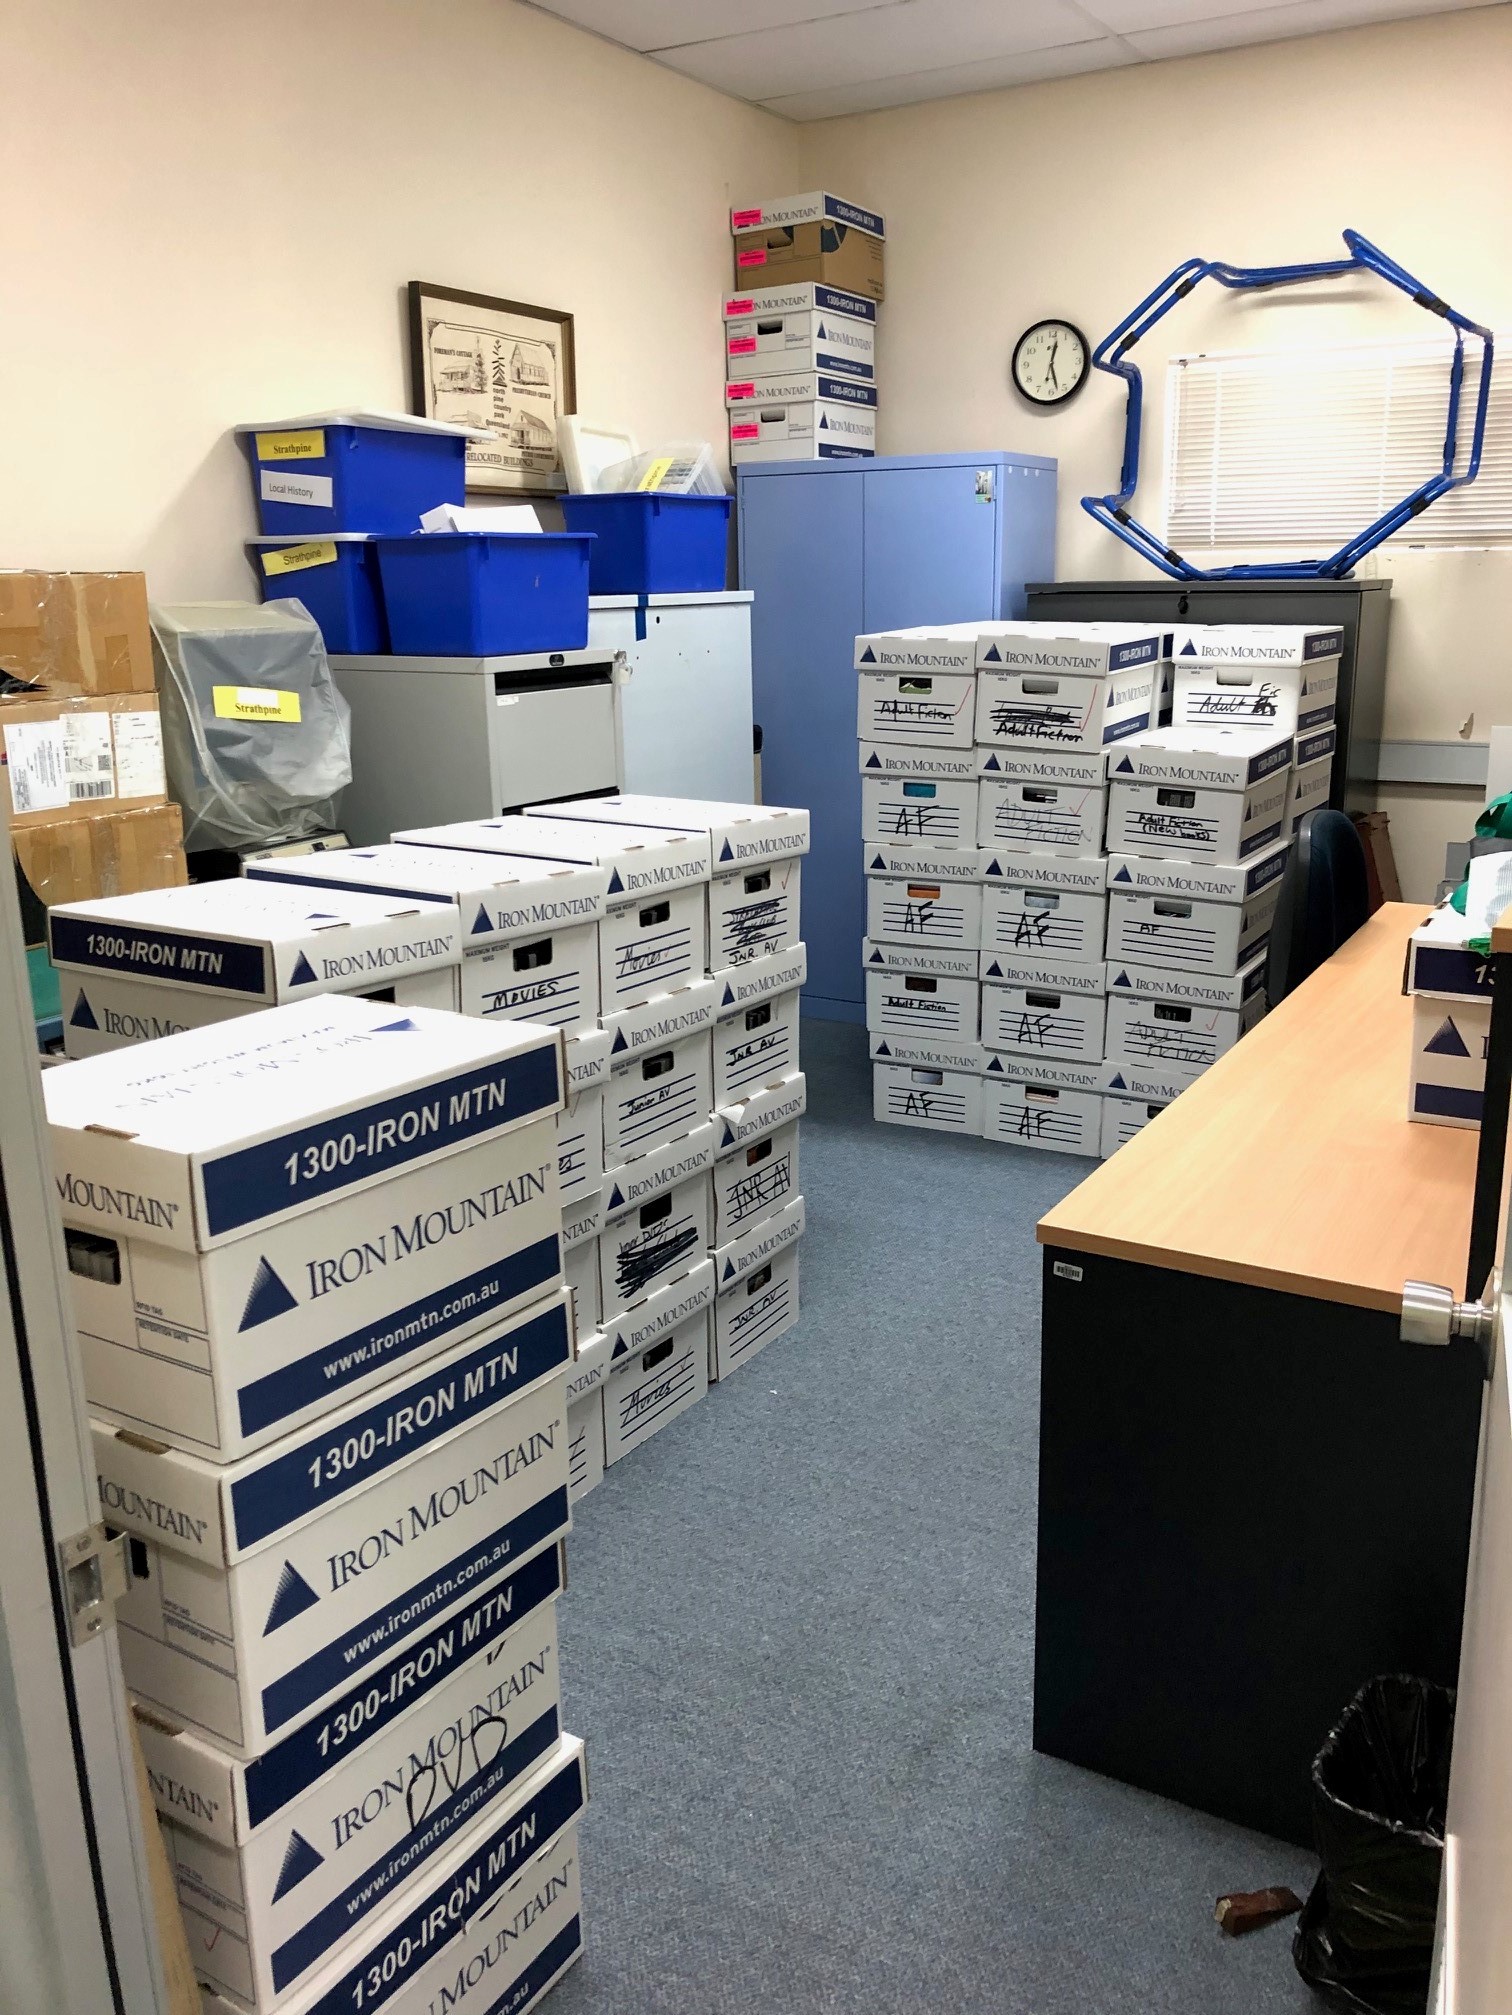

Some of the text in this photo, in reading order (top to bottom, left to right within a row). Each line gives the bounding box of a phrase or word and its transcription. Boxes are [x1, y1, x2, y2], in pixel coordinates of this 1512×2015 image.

[771, 206, 818, 222] MOUNTAIN
[762, 295, 807, 310] MOUNTAIN
[765, 385, 811, 397] MOUNTAIN
[273, 443, 312, 455] Strathpine
[466, 452, 501, 463] RELOCATED
[269, 483, 313, 499] Local History
[283, 548, 322, 566] Strathpine
[880, 652, 966, 666] IRON MOUNTAIN
[1005, 651, 1097, 668] IRON MOUNTAIN
[1201, 646, 1294, 659] IRON MOUNTAIN
[235, 703, 281, 716] Strathpine
[885, 758, 970, 772] IRON MOUNTAIN
[1005, 761, 1093, 779] IRON MOUNTAIN
[1138, 763, 1236, 784] IRON MOUNTAIN
[736, 834, 804, 859] IRON MOUNTAIN
[627, 861, 705, 890] IRON MOUNTAIN
[890, 860, 974, 876] IRON MOUNTAIN
[1006, 866, 1096, 886] IRON MOUNTAIN
[1136, 873, 1232, 894] IRON MOUNTAIN
[498, 896, 597, 930] IRON MOUNTAIN
[904, 901, 934, 934] AF
[86, 933, 223, 975] 1300-IRON MTN
[764, 939, 778, 953] AV
[322, 937, 451, 981] IRON MOUNTAIN
[888, 954, 969, 972] IRON MOUNTAIN
[737, 971, 800, 1000] IRON MOUNTAIN
[1007, 968, 1095, 989] IRON MOUNTAIN
[1136, 978, 1231, 1001] IRON MOUNTAIN
[104, 1007, 150, 1041] IRON
[631, 1007, 709, 1048] IRON MOUNTAIN
[760, 1036, 776, 1051] AV
[894, 1047, 975, 1067] IRON MOUNTAIN
[568, 1061, 602, 1081] NTAIN
[1007, 1063, 1094, 1085] IRON MOUNTAIN
[1131, 1080, 1160, 1094] IRON
[284, 1078, 507, 1185] 1300-IRON MTN
[737, 1099, 800, 1140] IRON MOUNTAIN
[628, 1150, 707, 1197] IRON MOUNTAIN
[562, 1216, 596, 1245] NTAIN
[737, 1222, 800, 1272] IRON MOUNTAIN
[306, 1236, 387, 1301] IRON
[323, 1278, 500, 1380] www.ironmtn.com.au
[630, 1286, 708, 1348] IRON MOUNTAIN
[566, 1367, 602, 1399] NTAIN
[307, 1346, 520, 1489] 1300-IRON MTN
[327, 1520, 405, 1593] IRON
[342, 1539, 511, 1664] www.ironmtn.com.au
[315, 1586, 515, 1757] 1300-IRON MTN
[148, 1768, 214, 1823] NTAIN
[331, 1768, 405, 1850] IRON
[346, 1766, 506, 1915] www.ironmtn.com.au
[351, 1812, 538, 2010] 1300-IRON MTN
